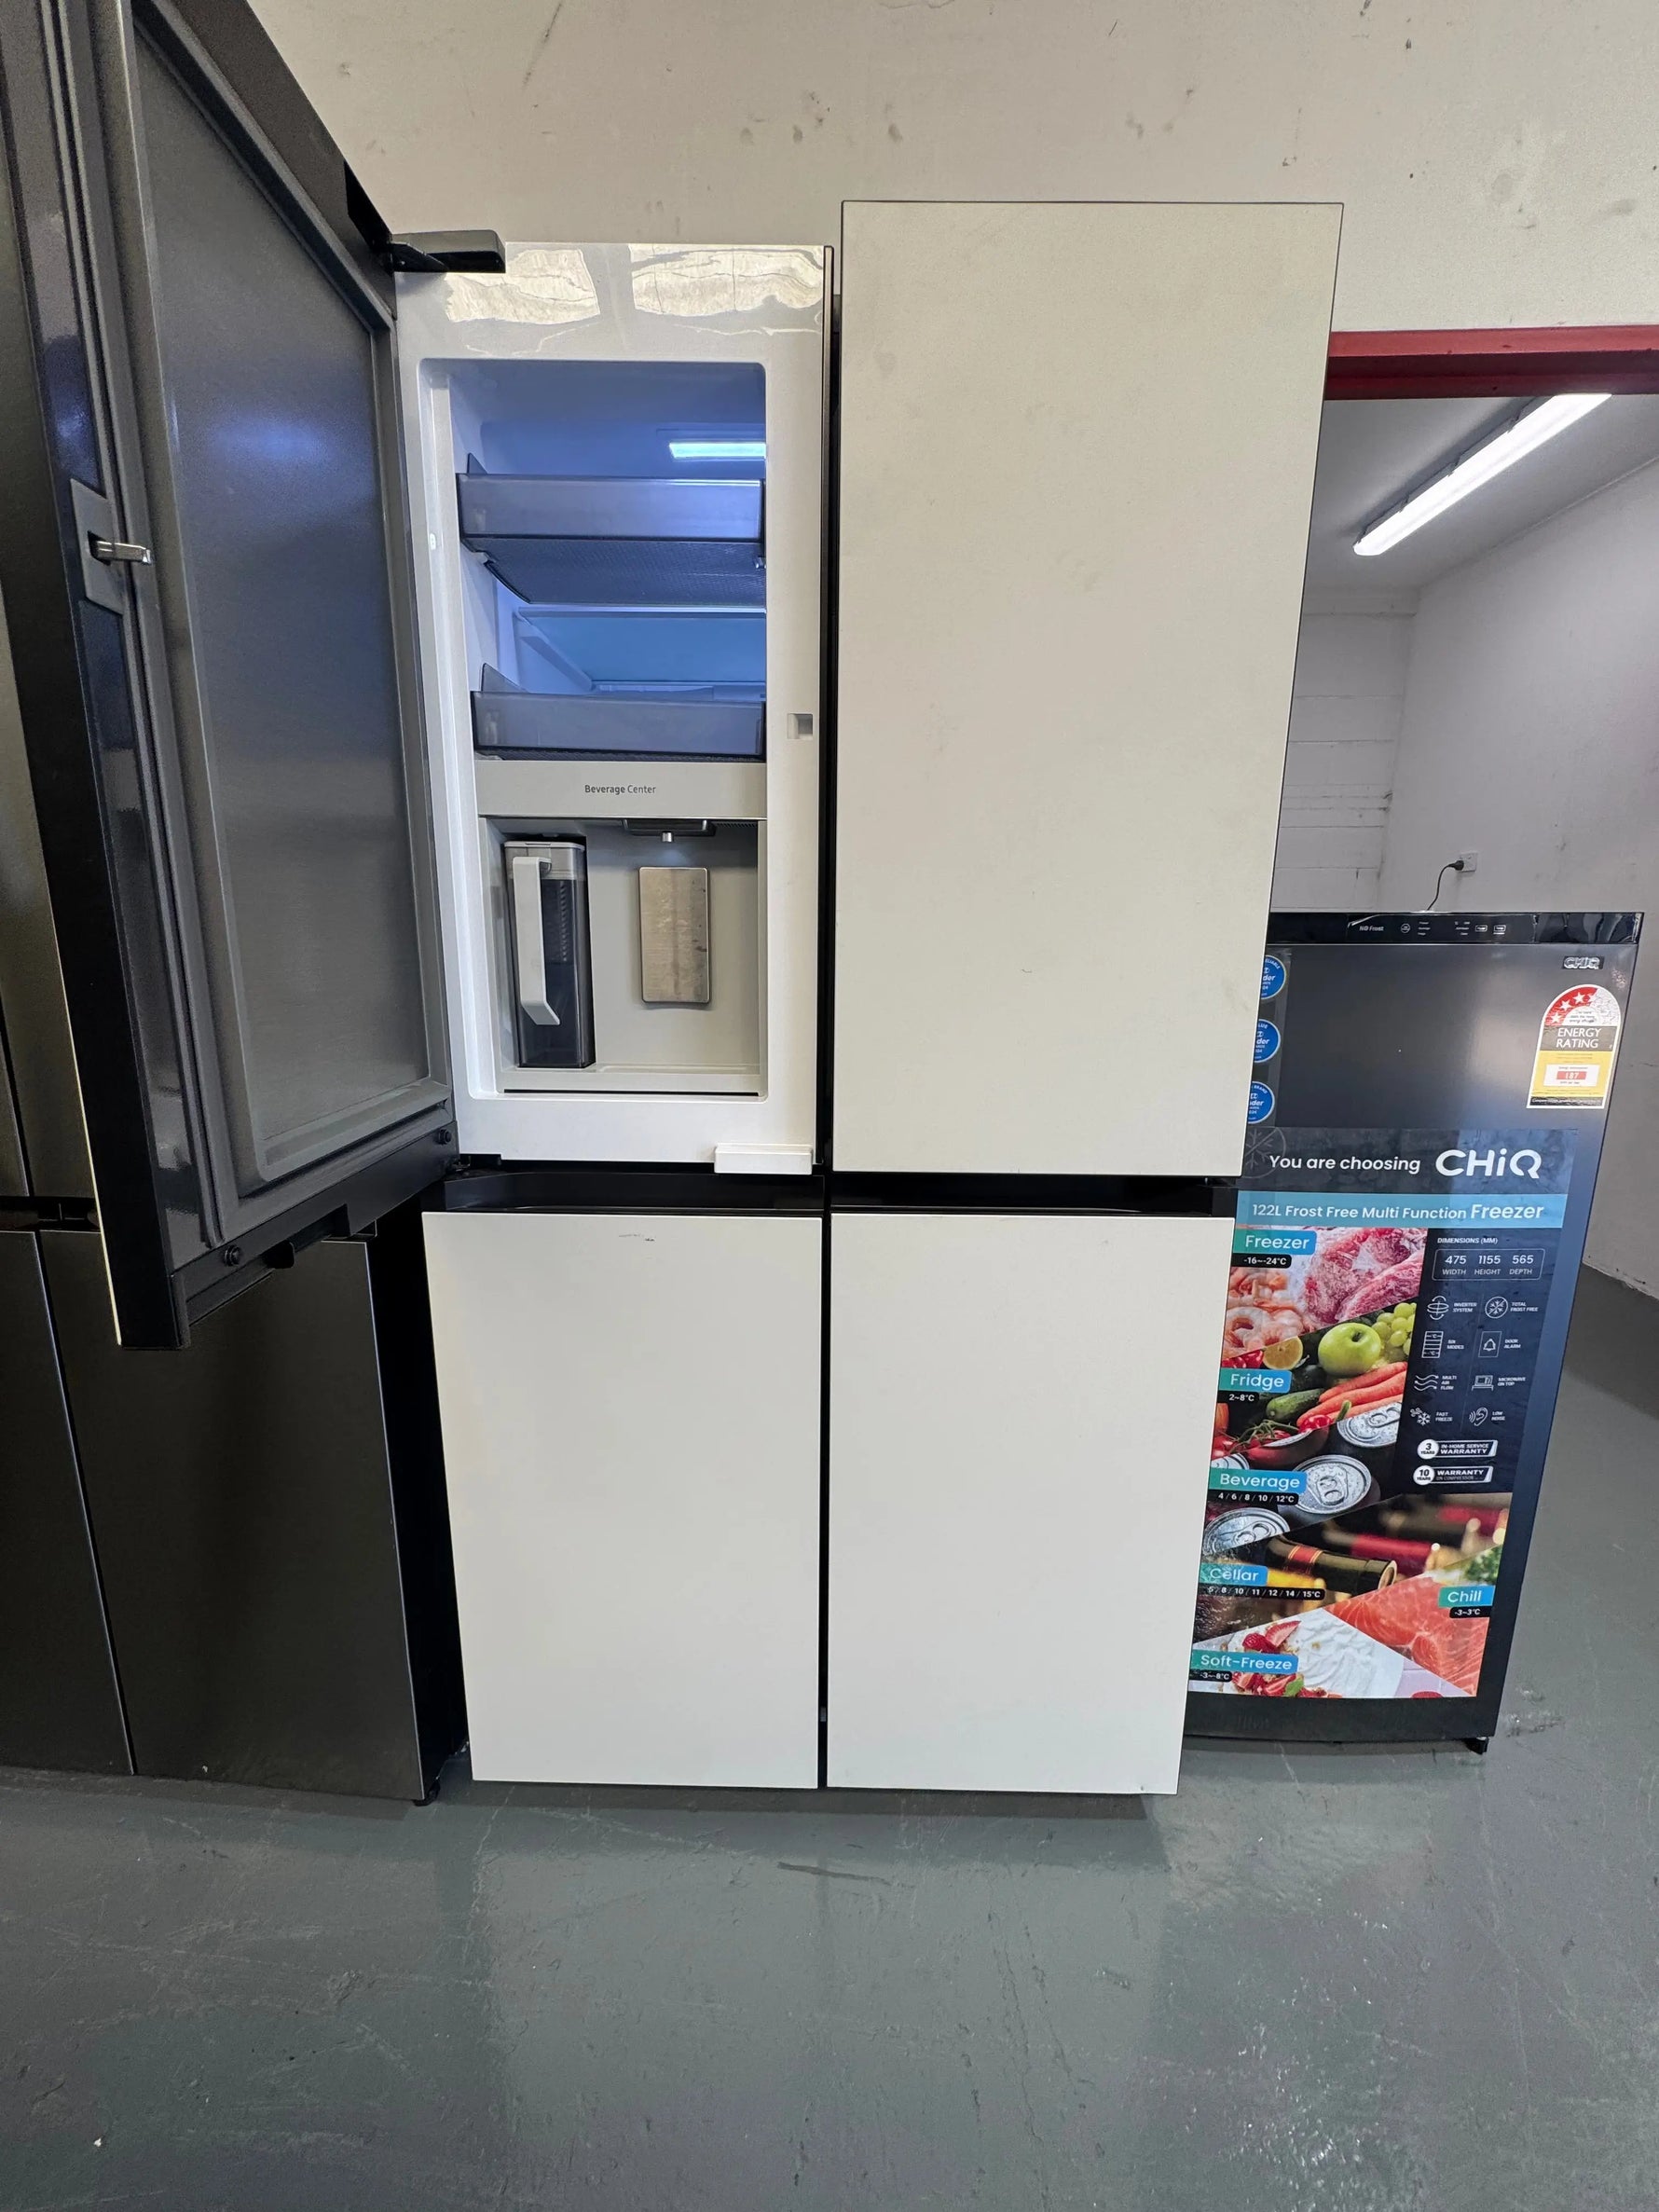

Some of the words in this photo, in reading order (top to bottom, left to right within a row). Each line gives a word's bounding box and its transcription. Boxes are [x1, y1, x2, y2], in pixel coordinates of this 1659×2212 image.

[584, 784, 625, 795] Beverage
[627, 784, 656, 793] Center
[1557, 1027, 1602, 1037] ENERGY
[1556, 1038, 1599, 1049] RATING
[1269, 1154, 1304, 1170] You
[1306, 1157, 1336, 1170] are
[1339, 1156, 1420, 1175] choosing
[1435, 1147, 1542, 1179] CHiQ
[1252, 1203, 1282, 1217] 122L
[1285, 1205, 1323, 1217] Frost
[1326, 1206, 1358, 1218] Free
[1362, 1206, 1399, 1219] Multi
[1402, 1206, 1467, 1220] Function
[1471, 1203, 1544, 1219] Freezer
[1245, 1235, 1309, 1249] Freezer
[1445, 1255, 1467, 1264] 475
[1478, 1255, 1501, 1264] 1155
[1512, 1255, 1534, 1264] 565
[1230, 1373, 1284, 1391] Fridge
[1220, 1473, 1300, 1491] Beverage
[1210, 1567, 1259, 1581] Cellar
[1447, 1590, 1482, 1602] Chill
[1200, 1655, 1293, 1669] Soft-Freeze
